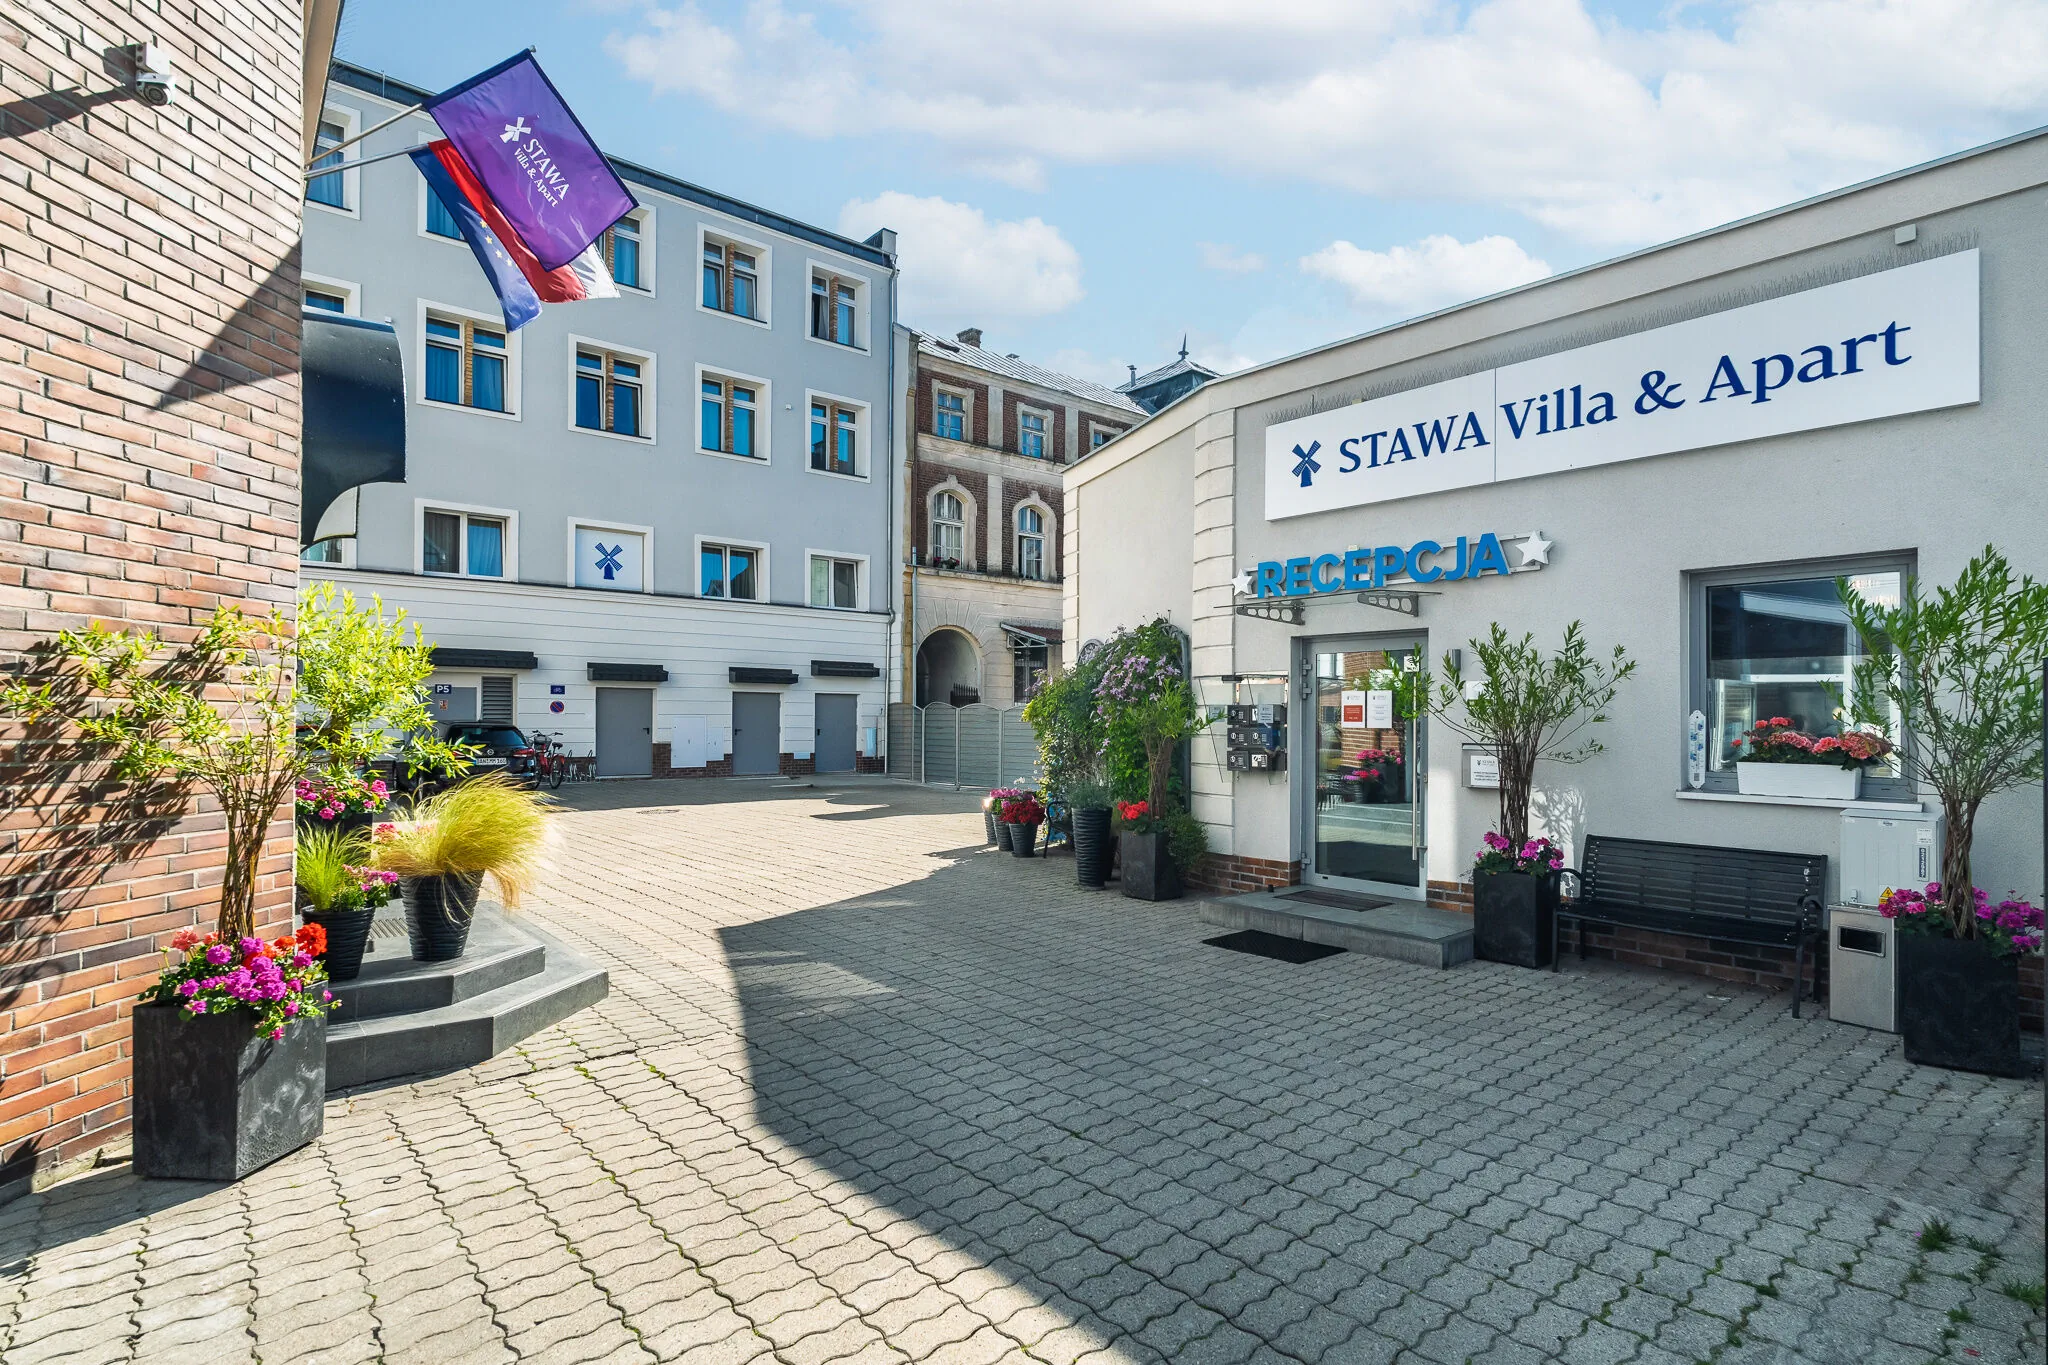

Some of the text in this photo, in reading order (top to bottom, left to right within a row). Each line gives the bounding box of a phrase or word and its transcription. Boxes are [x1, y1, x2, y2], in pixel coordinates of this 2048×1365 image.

[514, 148, 558, 207] Villa & Apart
[523, 139, 569, 200] STAWA
[1339, 320, 1914, 474] STAWA Villa & Apart
[1257, 532, 1510, 599] RECEPCJA
[437, 685, 450, 693] P5
